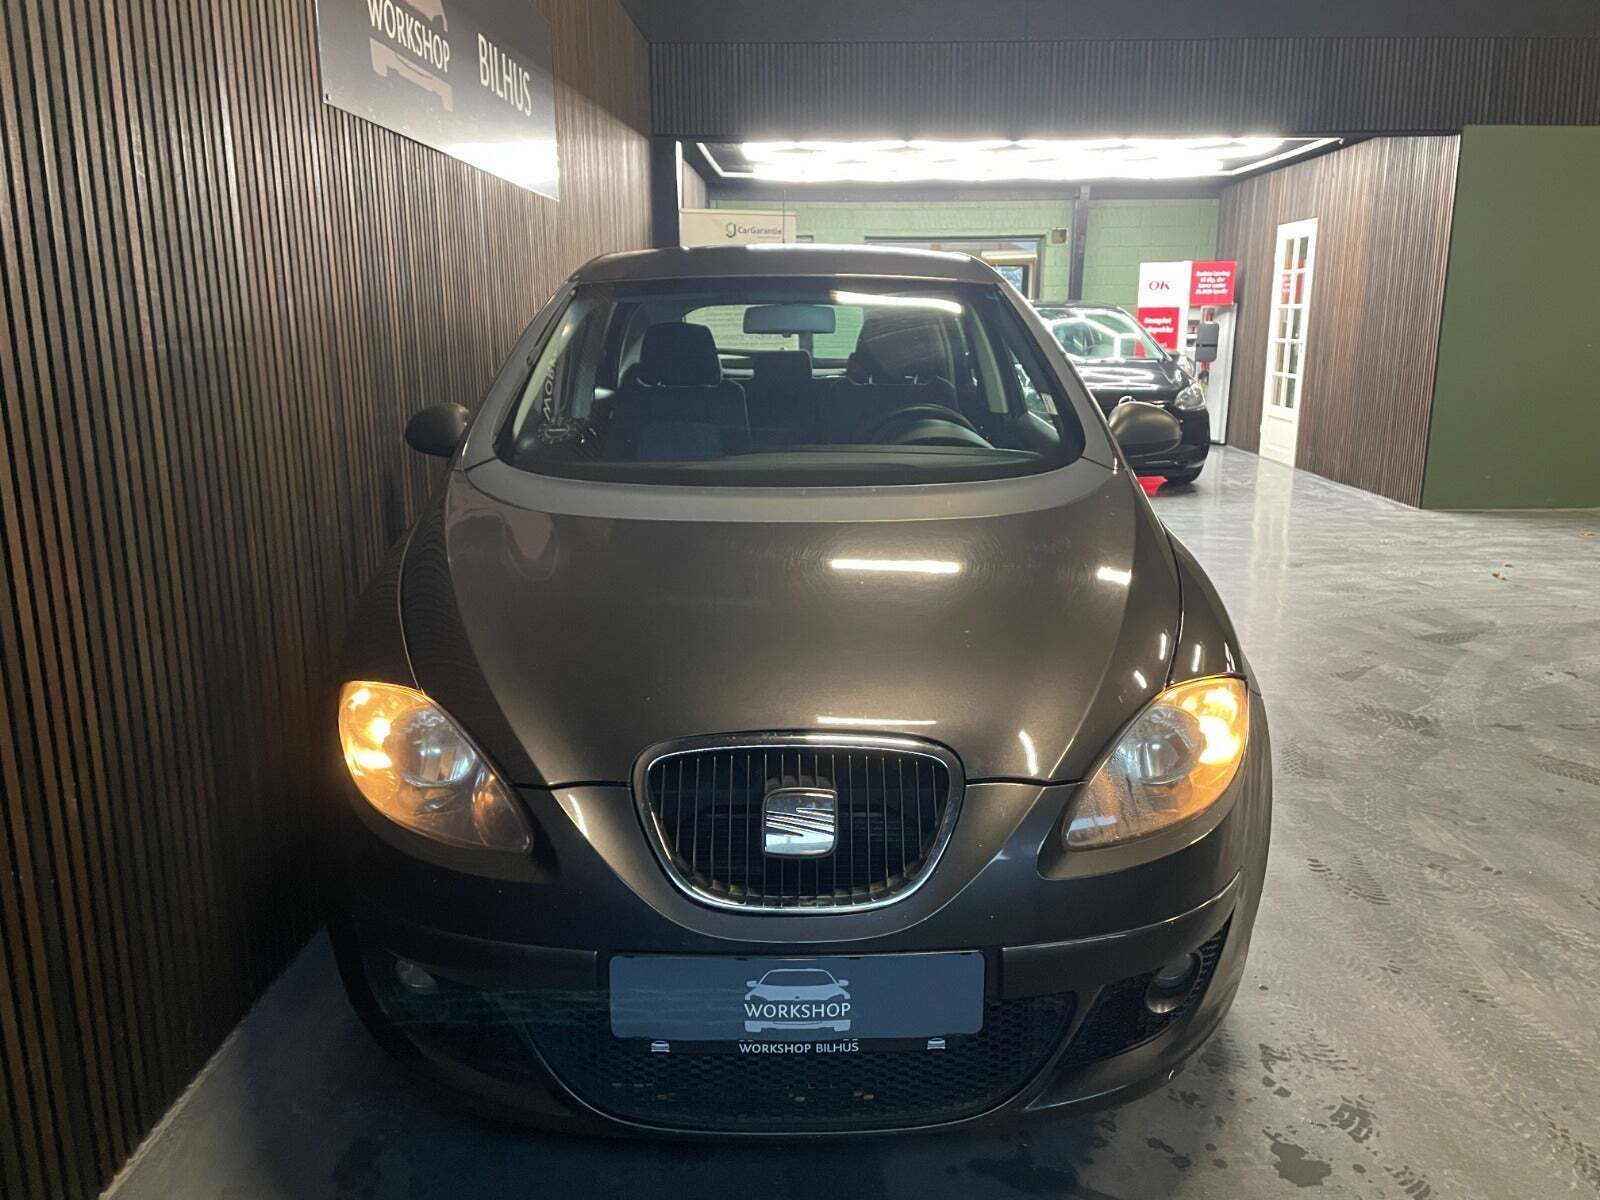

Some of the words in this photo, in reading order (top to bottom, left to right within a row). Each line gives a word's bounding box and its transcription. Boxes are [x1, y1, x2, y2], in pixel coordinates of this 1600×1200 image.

[366, 0, 450, 72] WORKSHOP
[478, 33, 532, 117] BILHUS
[1149, 281, 1171, 291] OK
[744, 1002, 851, 1018] WORKSHOP
[739, 1043, 812, 1054] WORKSHOP
[815, 1042, 859, 1053] BILHUS
